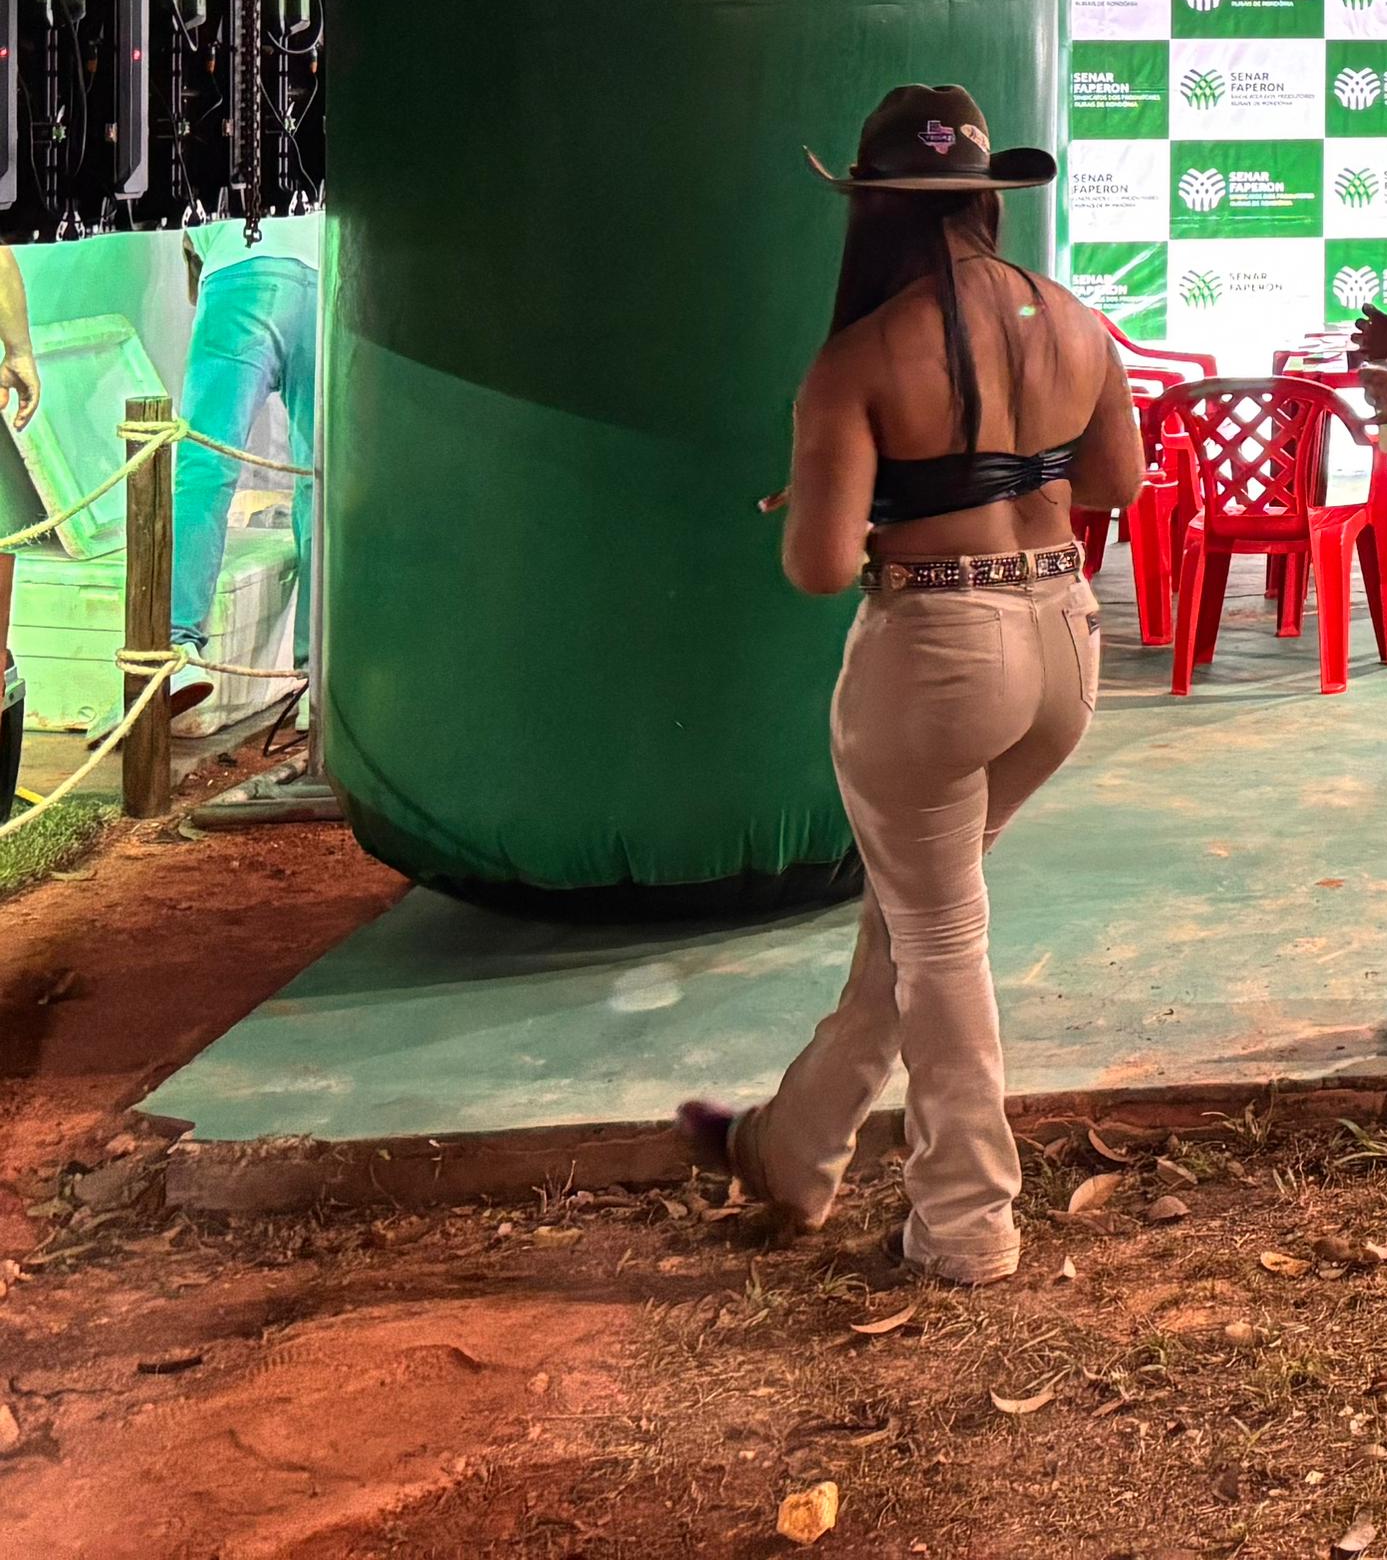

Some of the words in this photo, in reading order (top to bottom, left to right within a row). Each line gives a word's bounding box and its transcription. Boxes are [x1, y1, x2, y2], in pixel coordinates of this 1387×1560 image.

[1073, 72, 1114, 82] SENAR
[1231, 72, 1269, 81] SENAR
[1073, 83, 1130, 93] FAPERON
[1231, 83, 1284, 92] FAPERON
[1073, 173, 1113, 183] SENAR
[1073, 184, 1129, 194] FAPERON
